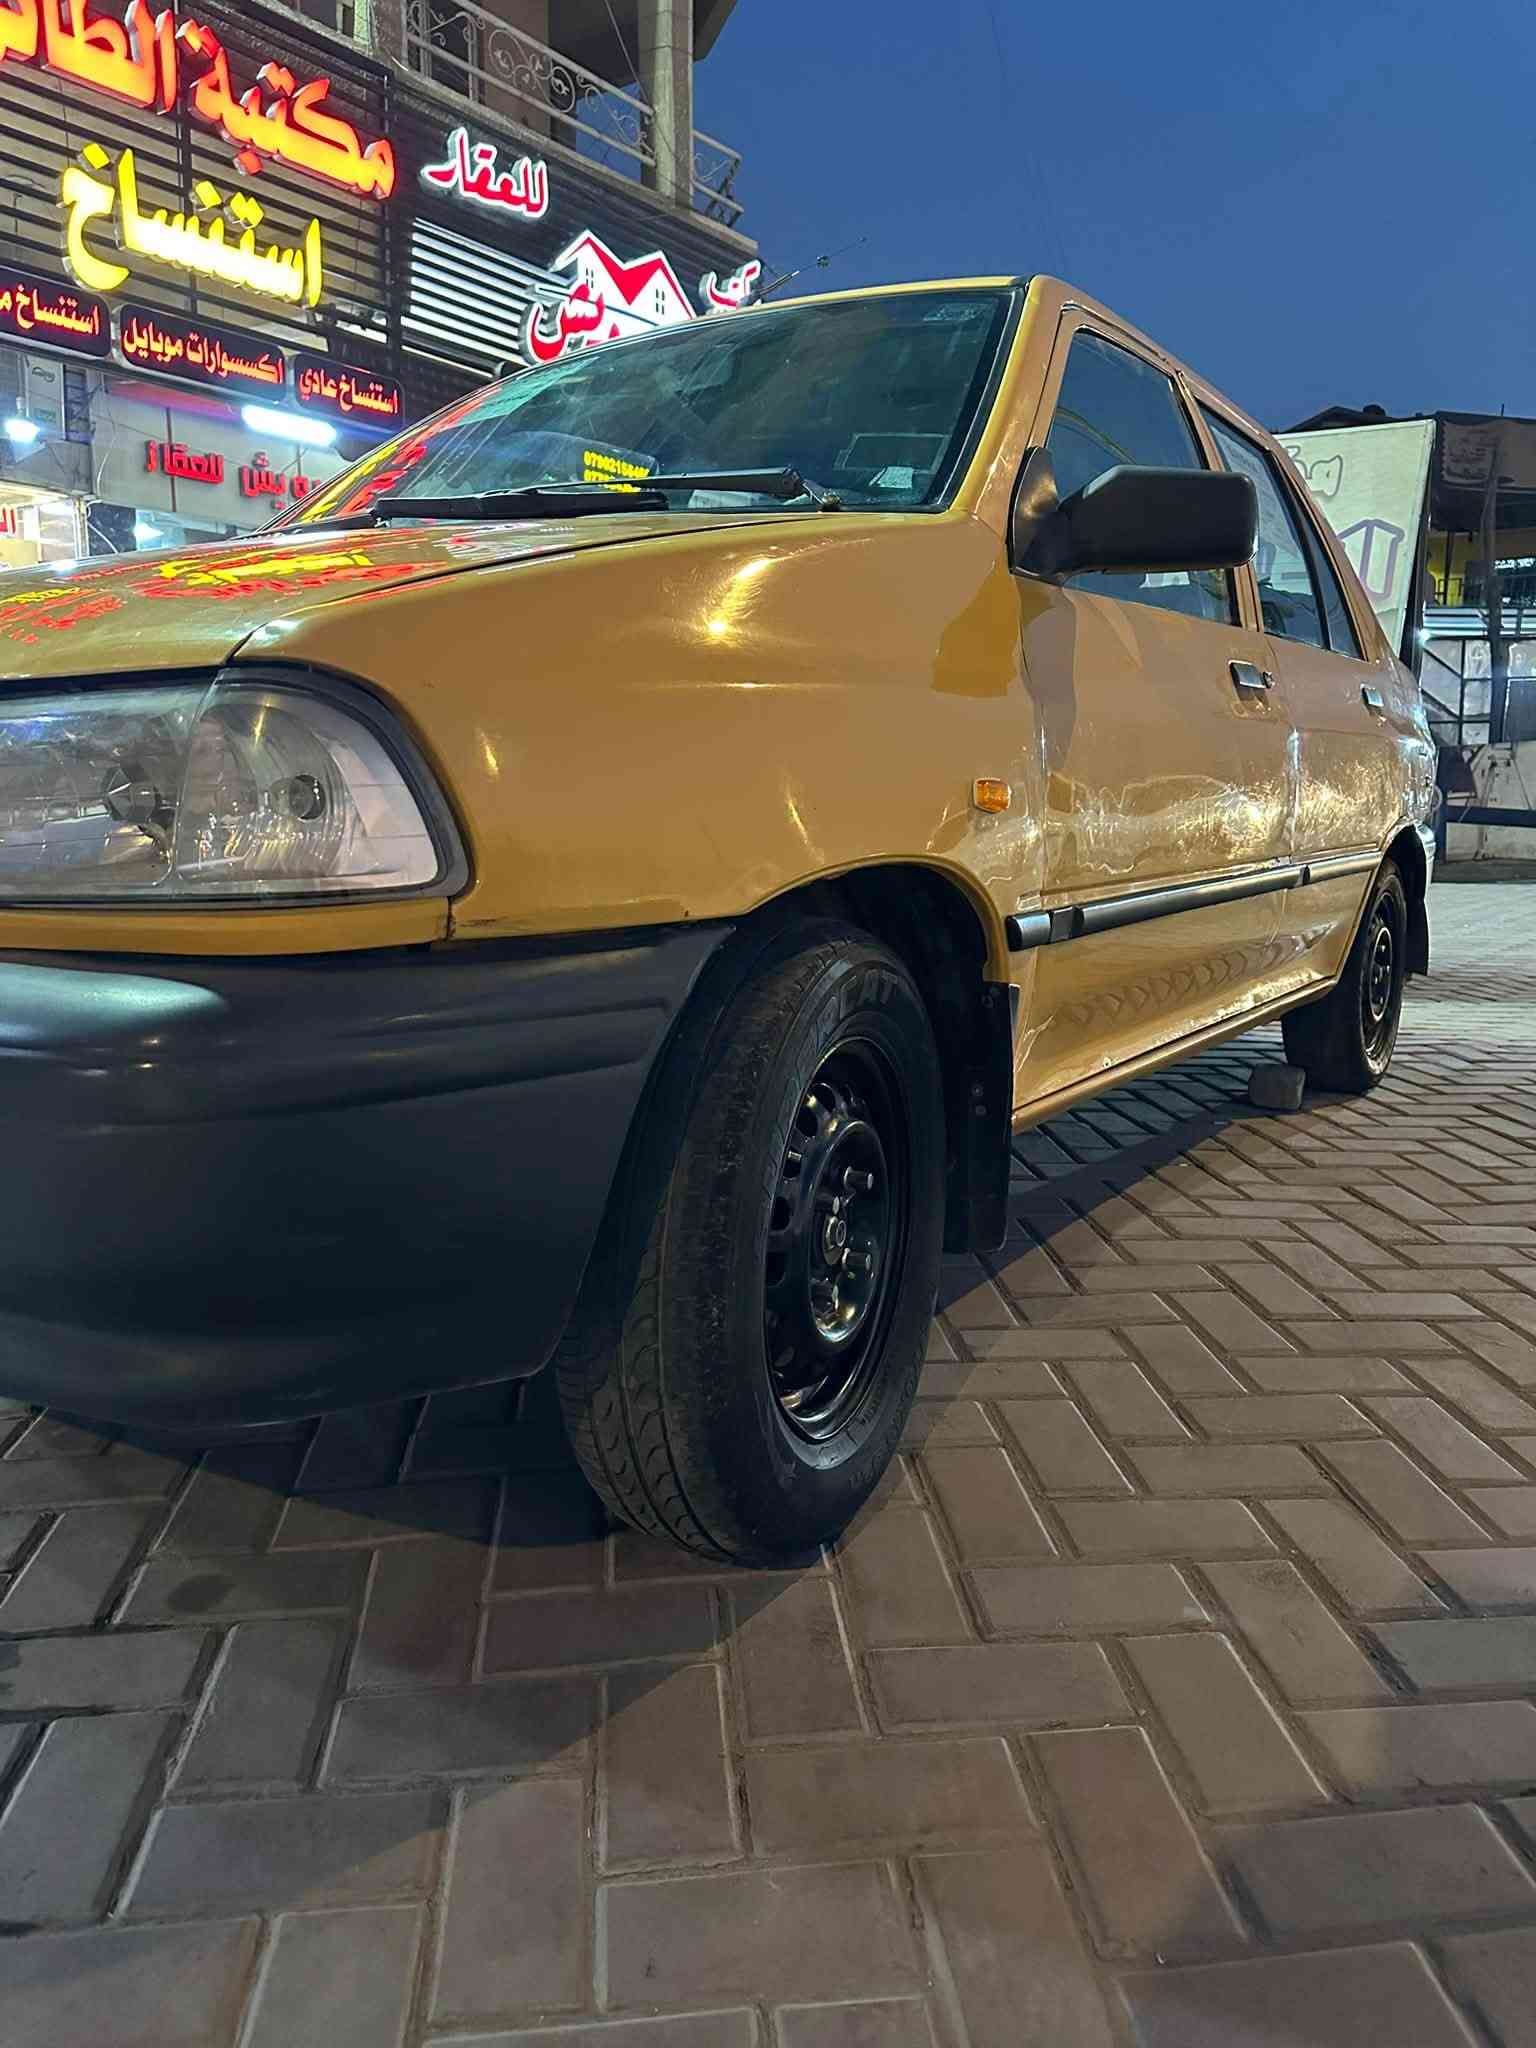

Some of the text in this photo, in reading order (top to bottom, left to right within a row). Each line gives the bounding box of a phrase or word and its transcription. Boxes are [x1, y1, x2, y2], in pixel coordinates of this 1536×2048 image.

[176, 18, 396, 199] مكتبة
[420, 127, 549, 218] للعقار
[57, 143, 323, 308] استنساخ
[16, 283, 99, 335] استنساخ
[122, 317, 284, 384] اكسسوارات موبايل
[300, 366, 398, 414] استنساخ عادي
